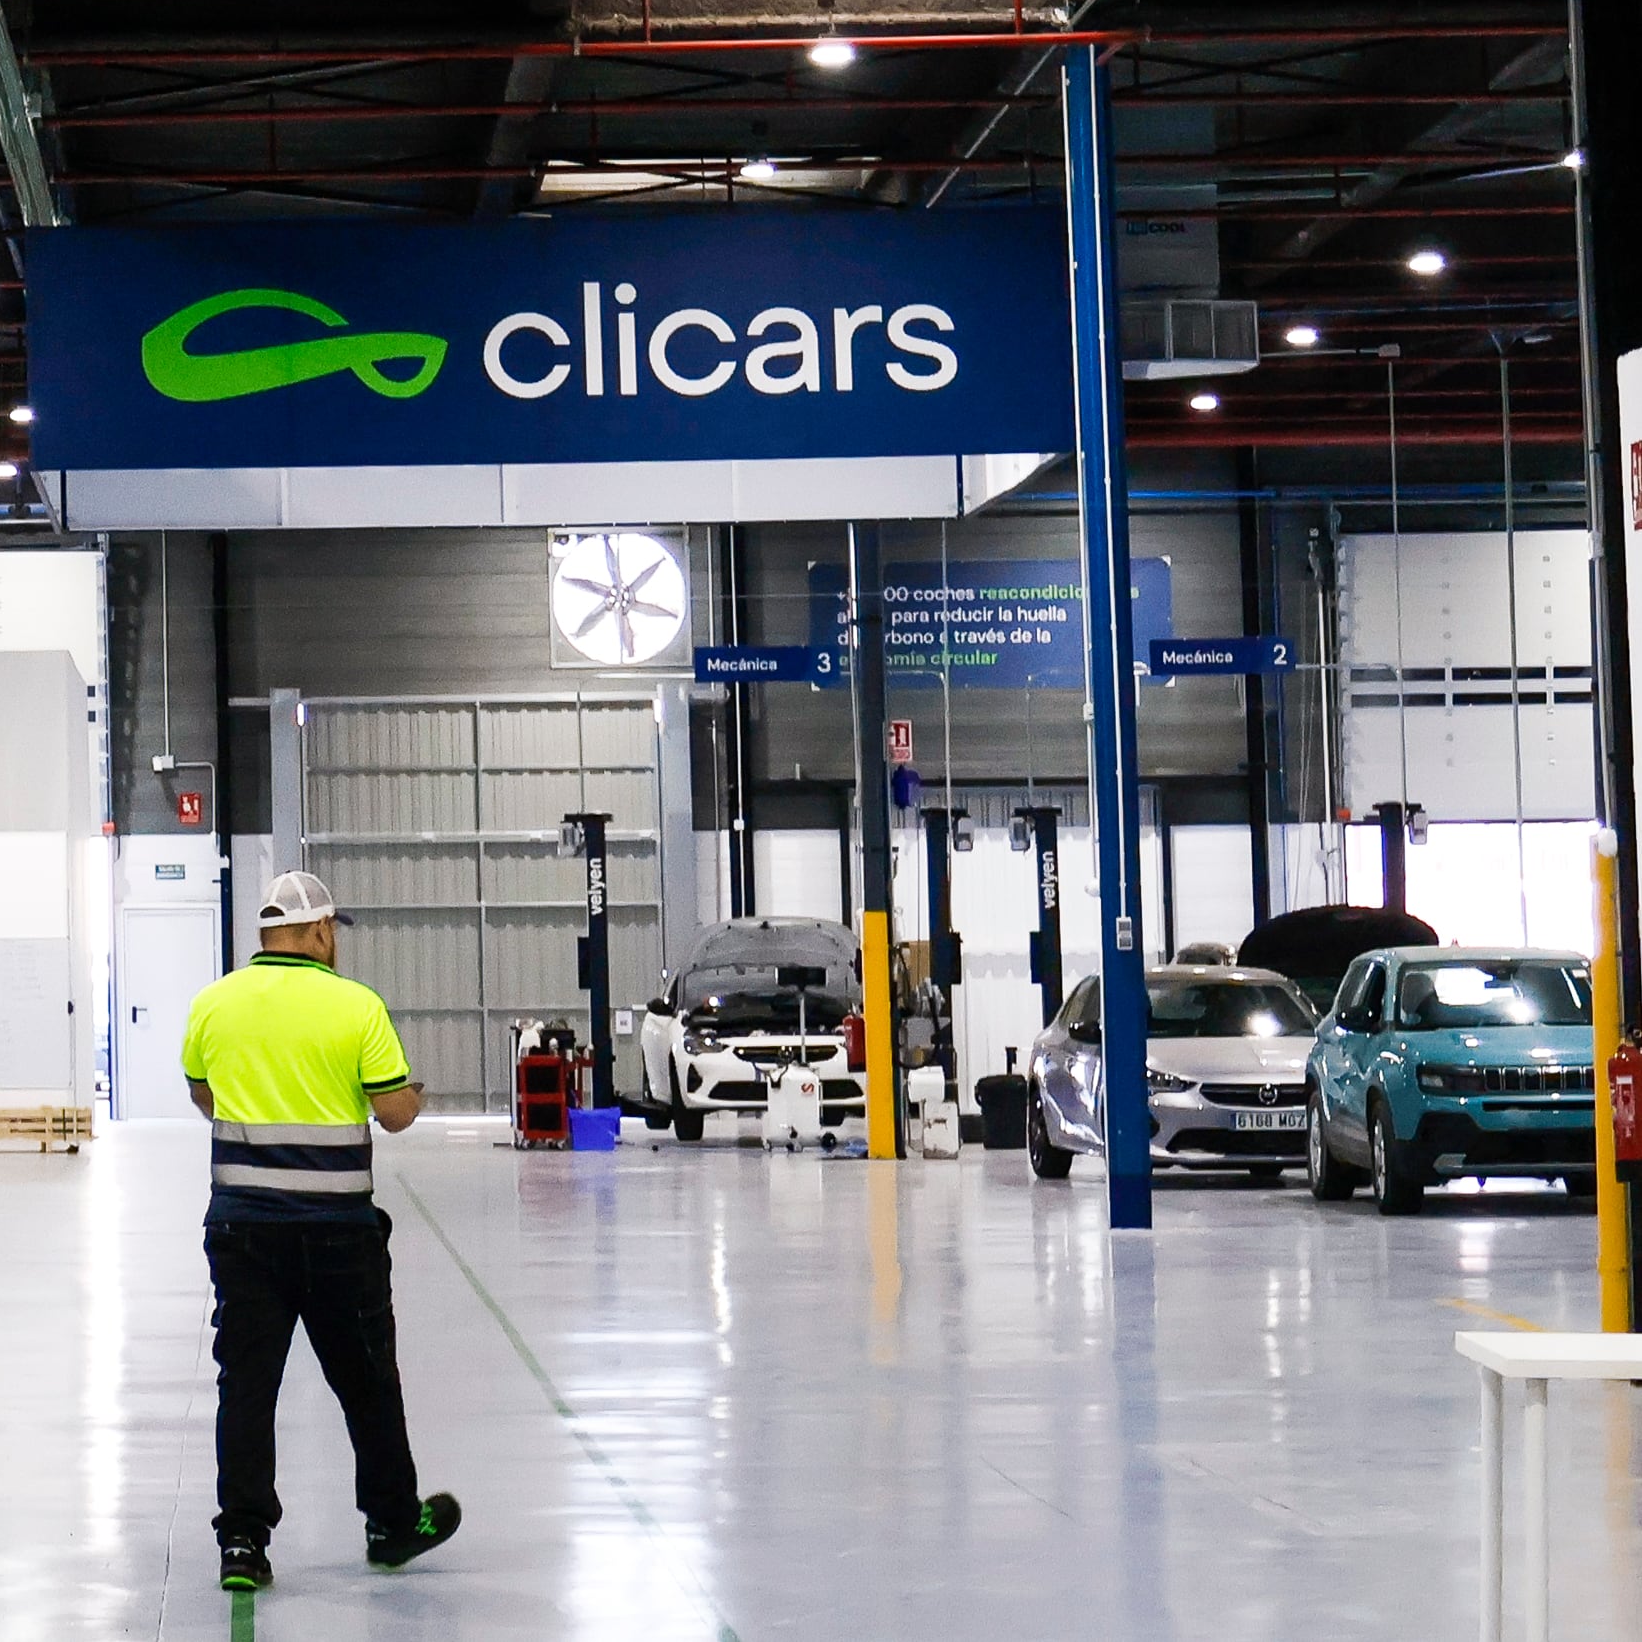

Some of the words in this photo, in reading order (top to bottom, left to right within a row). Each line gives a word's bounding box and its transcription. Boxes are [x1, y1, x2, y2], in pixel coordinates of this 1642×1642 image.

[483, 281, 958, 399] clicars
[913, 587, 975, 601] coches
[892, 611, 929, 626] para
[934, 607, 994, 622] reducir
[998, 606, 1013, 622] la
[1017, 605, 1067, 622] huella
[954, 628, 1006, 644] través
[1010, 628, 1032, 643] de
[1037, 628, 1051, 643] la
[707, 657, 778, 671] Mecánica
[817, 652, 831, 673] 3
[930, 649, 998, 665] circular
[1162, 649, 1233, 664] Mecánica
[1273, 644, 1288, 665] 2
[588, 858, 606, 915] velyen
[1041, 851, 1058, 909] velyen
